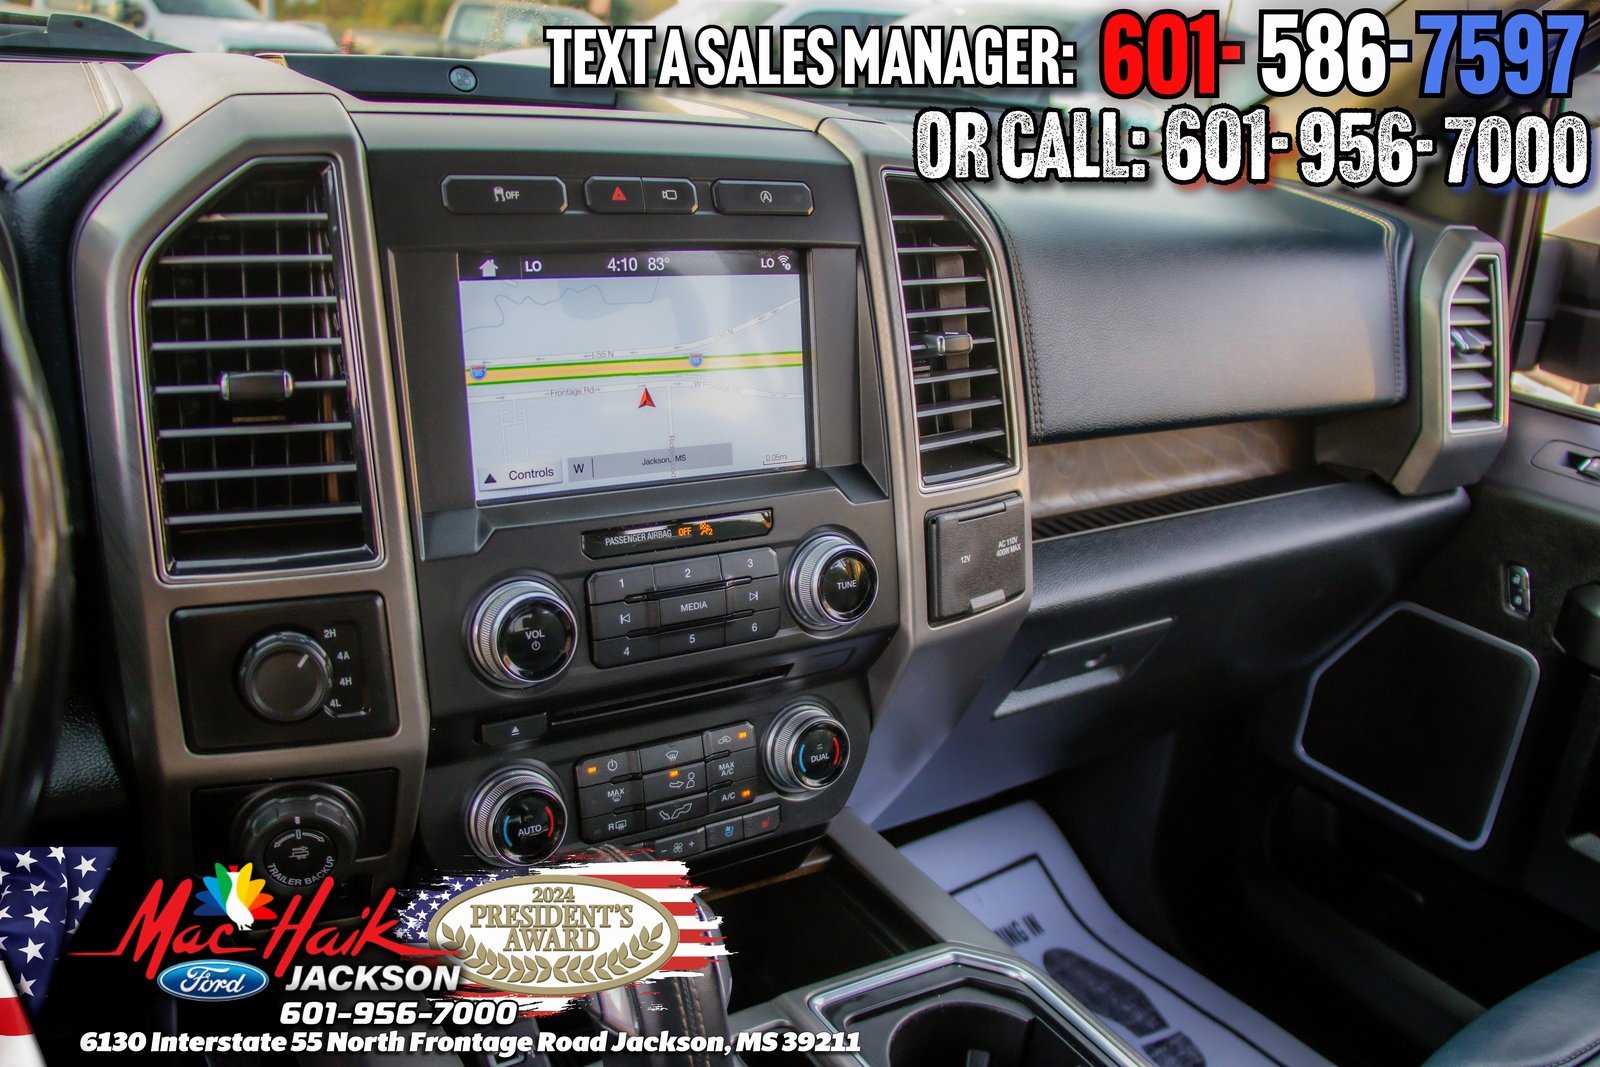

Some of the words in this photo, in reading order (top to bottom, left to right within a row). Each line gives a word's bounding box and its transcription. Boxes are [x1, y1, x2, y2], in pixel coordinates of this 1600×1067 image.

[505, 190, 520, 200] OFF
[525, 260, 542, 272] LO
[607, 257, 638, 272] 4:10
[647, 257, 670, 272] 83°
[761, 258, 775, 269] LO
[551, 388, 582, 397] Frontage
[583, 386, 595, 394] Rd
[674, 454, 687, 463] MS
[508, 467, 554, 482] Controls
[573, 464, 584, 474] W
[605, 533, 646, 547] PASSENGER
[647, 529, 672, 541] AIRBAG
[678, 526, 692, 537] OFF
[747, 558, 754, 569] 3
[960, 554, 972, 564] 12V
[684, 568, 691, 578] 2
[618, 578, 624, 588] 1
[836, 578, 858, 590] TUNE
[680, 599, 708, 613] MEDIA
[751, 622, 758, 632] 6
[323, 628, 337, 639] 2H
[525, 629, 545, 640] VOL
[689, 633, 696, 644] 5
[337, 650, 350, 661] 4A
[622, 646, 630, 656] 4
[339, 676, 352, 687] 4H
[330, 698, 342, 708] 4L
[810, 752, 830, 763] DUAL
[718, 761, 735, 771] MAX
[721, 768, 734, 777] A/C
[607, 788, 625, 797] MAX
[721, 792, 736, 802] A/C
[517, 824, 543, 837] AUTO
[608, 823, 615, 831] R
[267, 862, 302, 886] TRAILER
[303, 855, 335, 885] BACKUP
